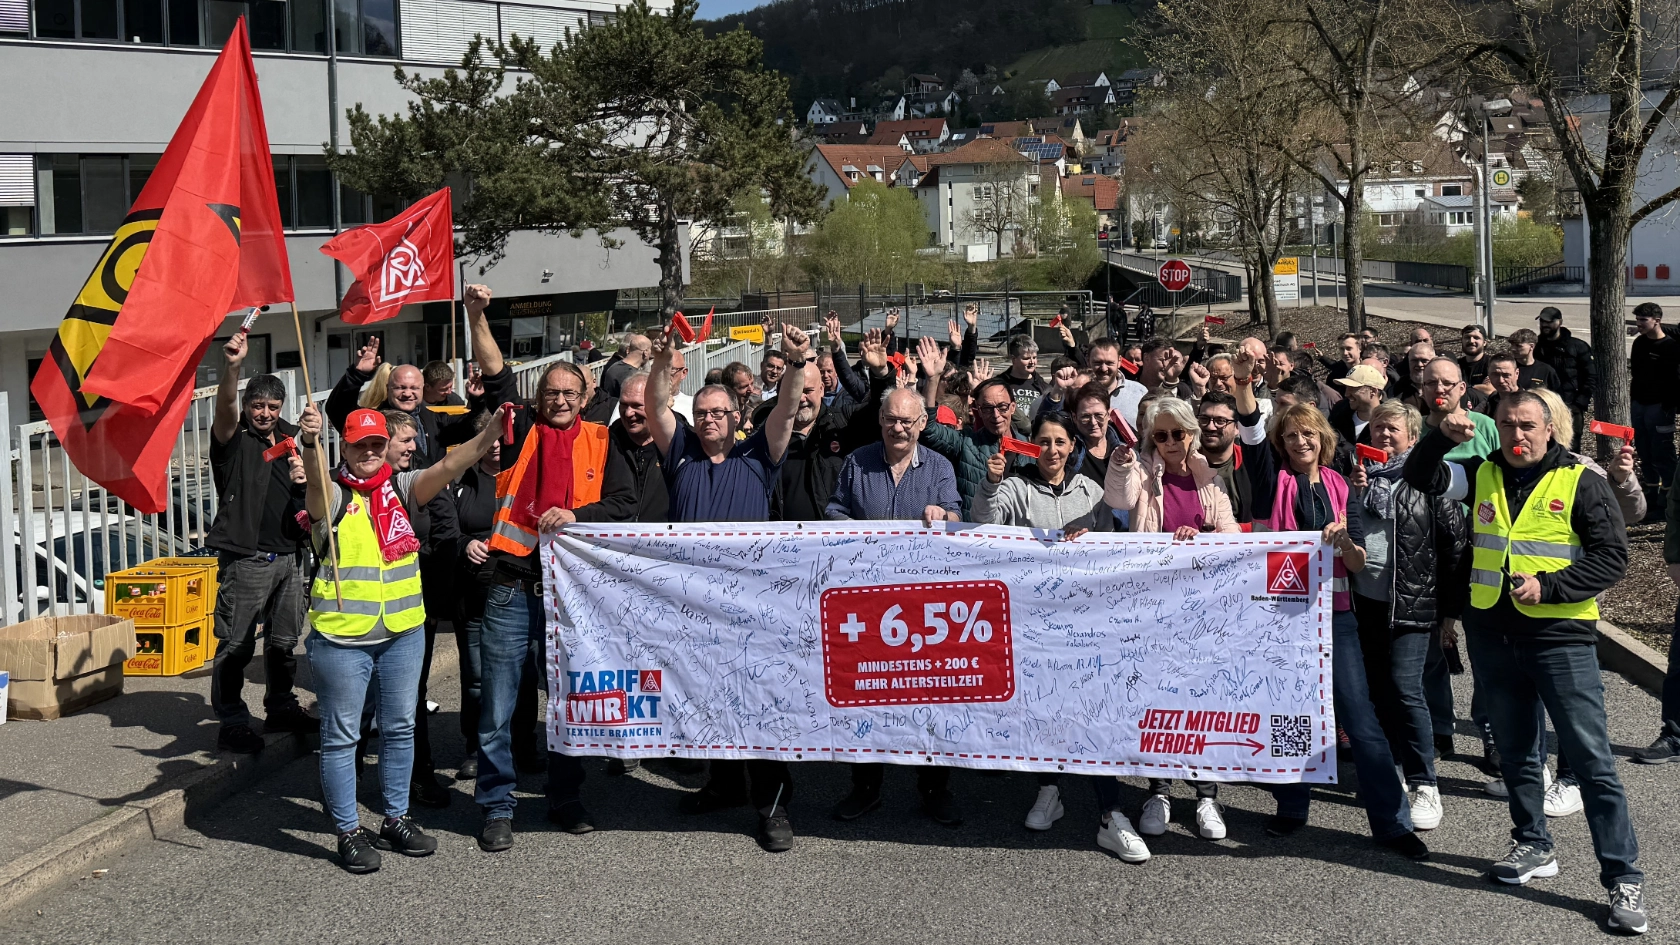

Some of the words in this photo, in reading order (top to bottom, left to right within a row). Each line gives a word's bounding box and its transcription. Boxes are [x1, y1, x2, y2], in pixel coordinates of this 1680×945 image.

[1161, 269, 1189, 282] STOP
[510, 300, 552, 310] ANMELDUNG
[894, 566, 918, 575] Luca
[921, 566, 961, 576] Feuchter
[1250, 595, 1310, 604] Baden-Württemberg
[839, 612, 866, 643] +
[879, 600, 993, 653] 6,5%
[857, 658, 932, 673] MINDESTENS
[934, 660, 943, 669] +
[944, 657, 969, 670] 200
[971, 657, 980, 668] €
[566, 670, 639, 694] TARIF
[854, 678, 888, 691] MEHR
[891, 675, 984, 690] ALTERSTEILZEIT
[1138, 708, 1184, 730] JETZT
[1184, 710, 1261, 734] MITGLIED
[566, 727, 606, 737] TEXTILE
[608, 727, 662, 738] BRANCHEN
[1139, 731, 1207, 755] WERDEN
